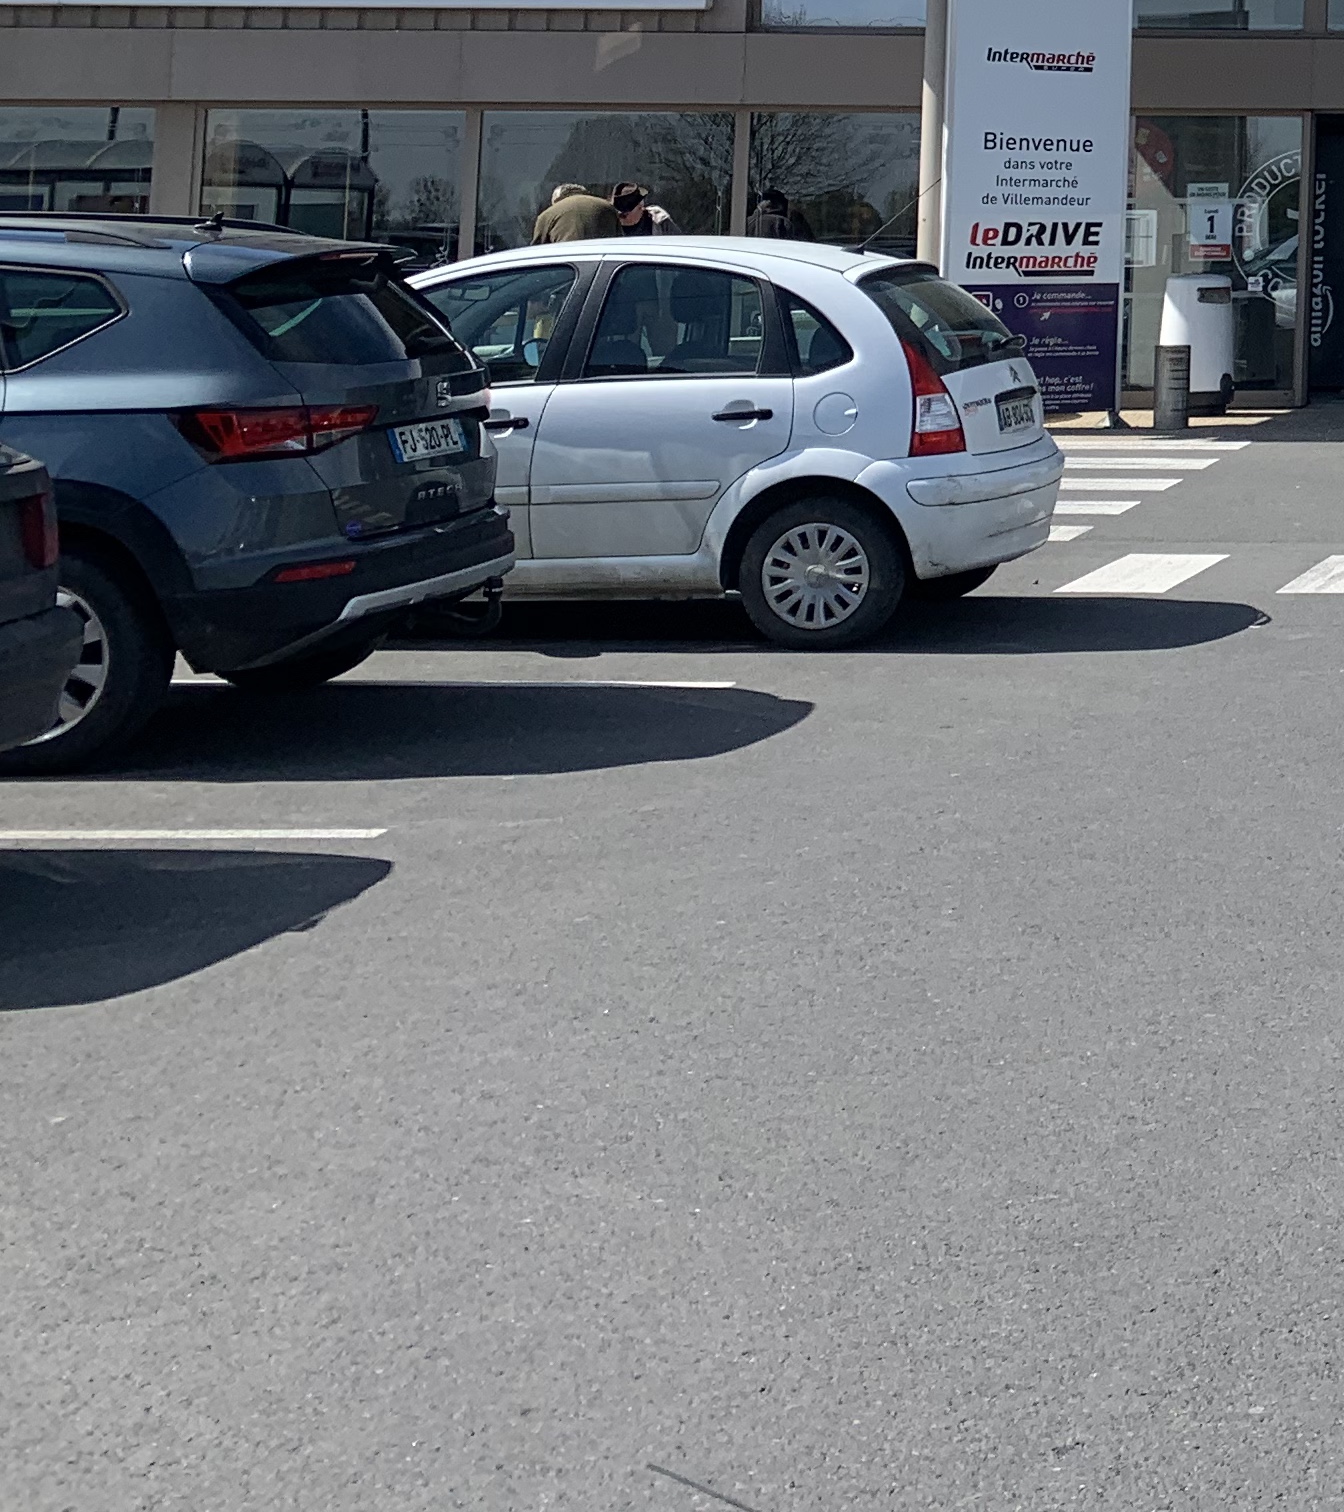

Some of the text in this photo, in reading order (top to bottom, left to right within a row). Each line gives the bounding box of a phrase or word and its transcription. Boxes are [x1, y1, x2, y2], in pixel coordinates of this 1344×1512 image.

[984, 131, 1094, 153] Bienvenue
[1004, 158, 1073, 171] dans votre
[996, 175, 1079, 188] Intermarché
[982, 193, 1091, 206] de Villemandeur
[1207, 215, 1215, 233] 1
